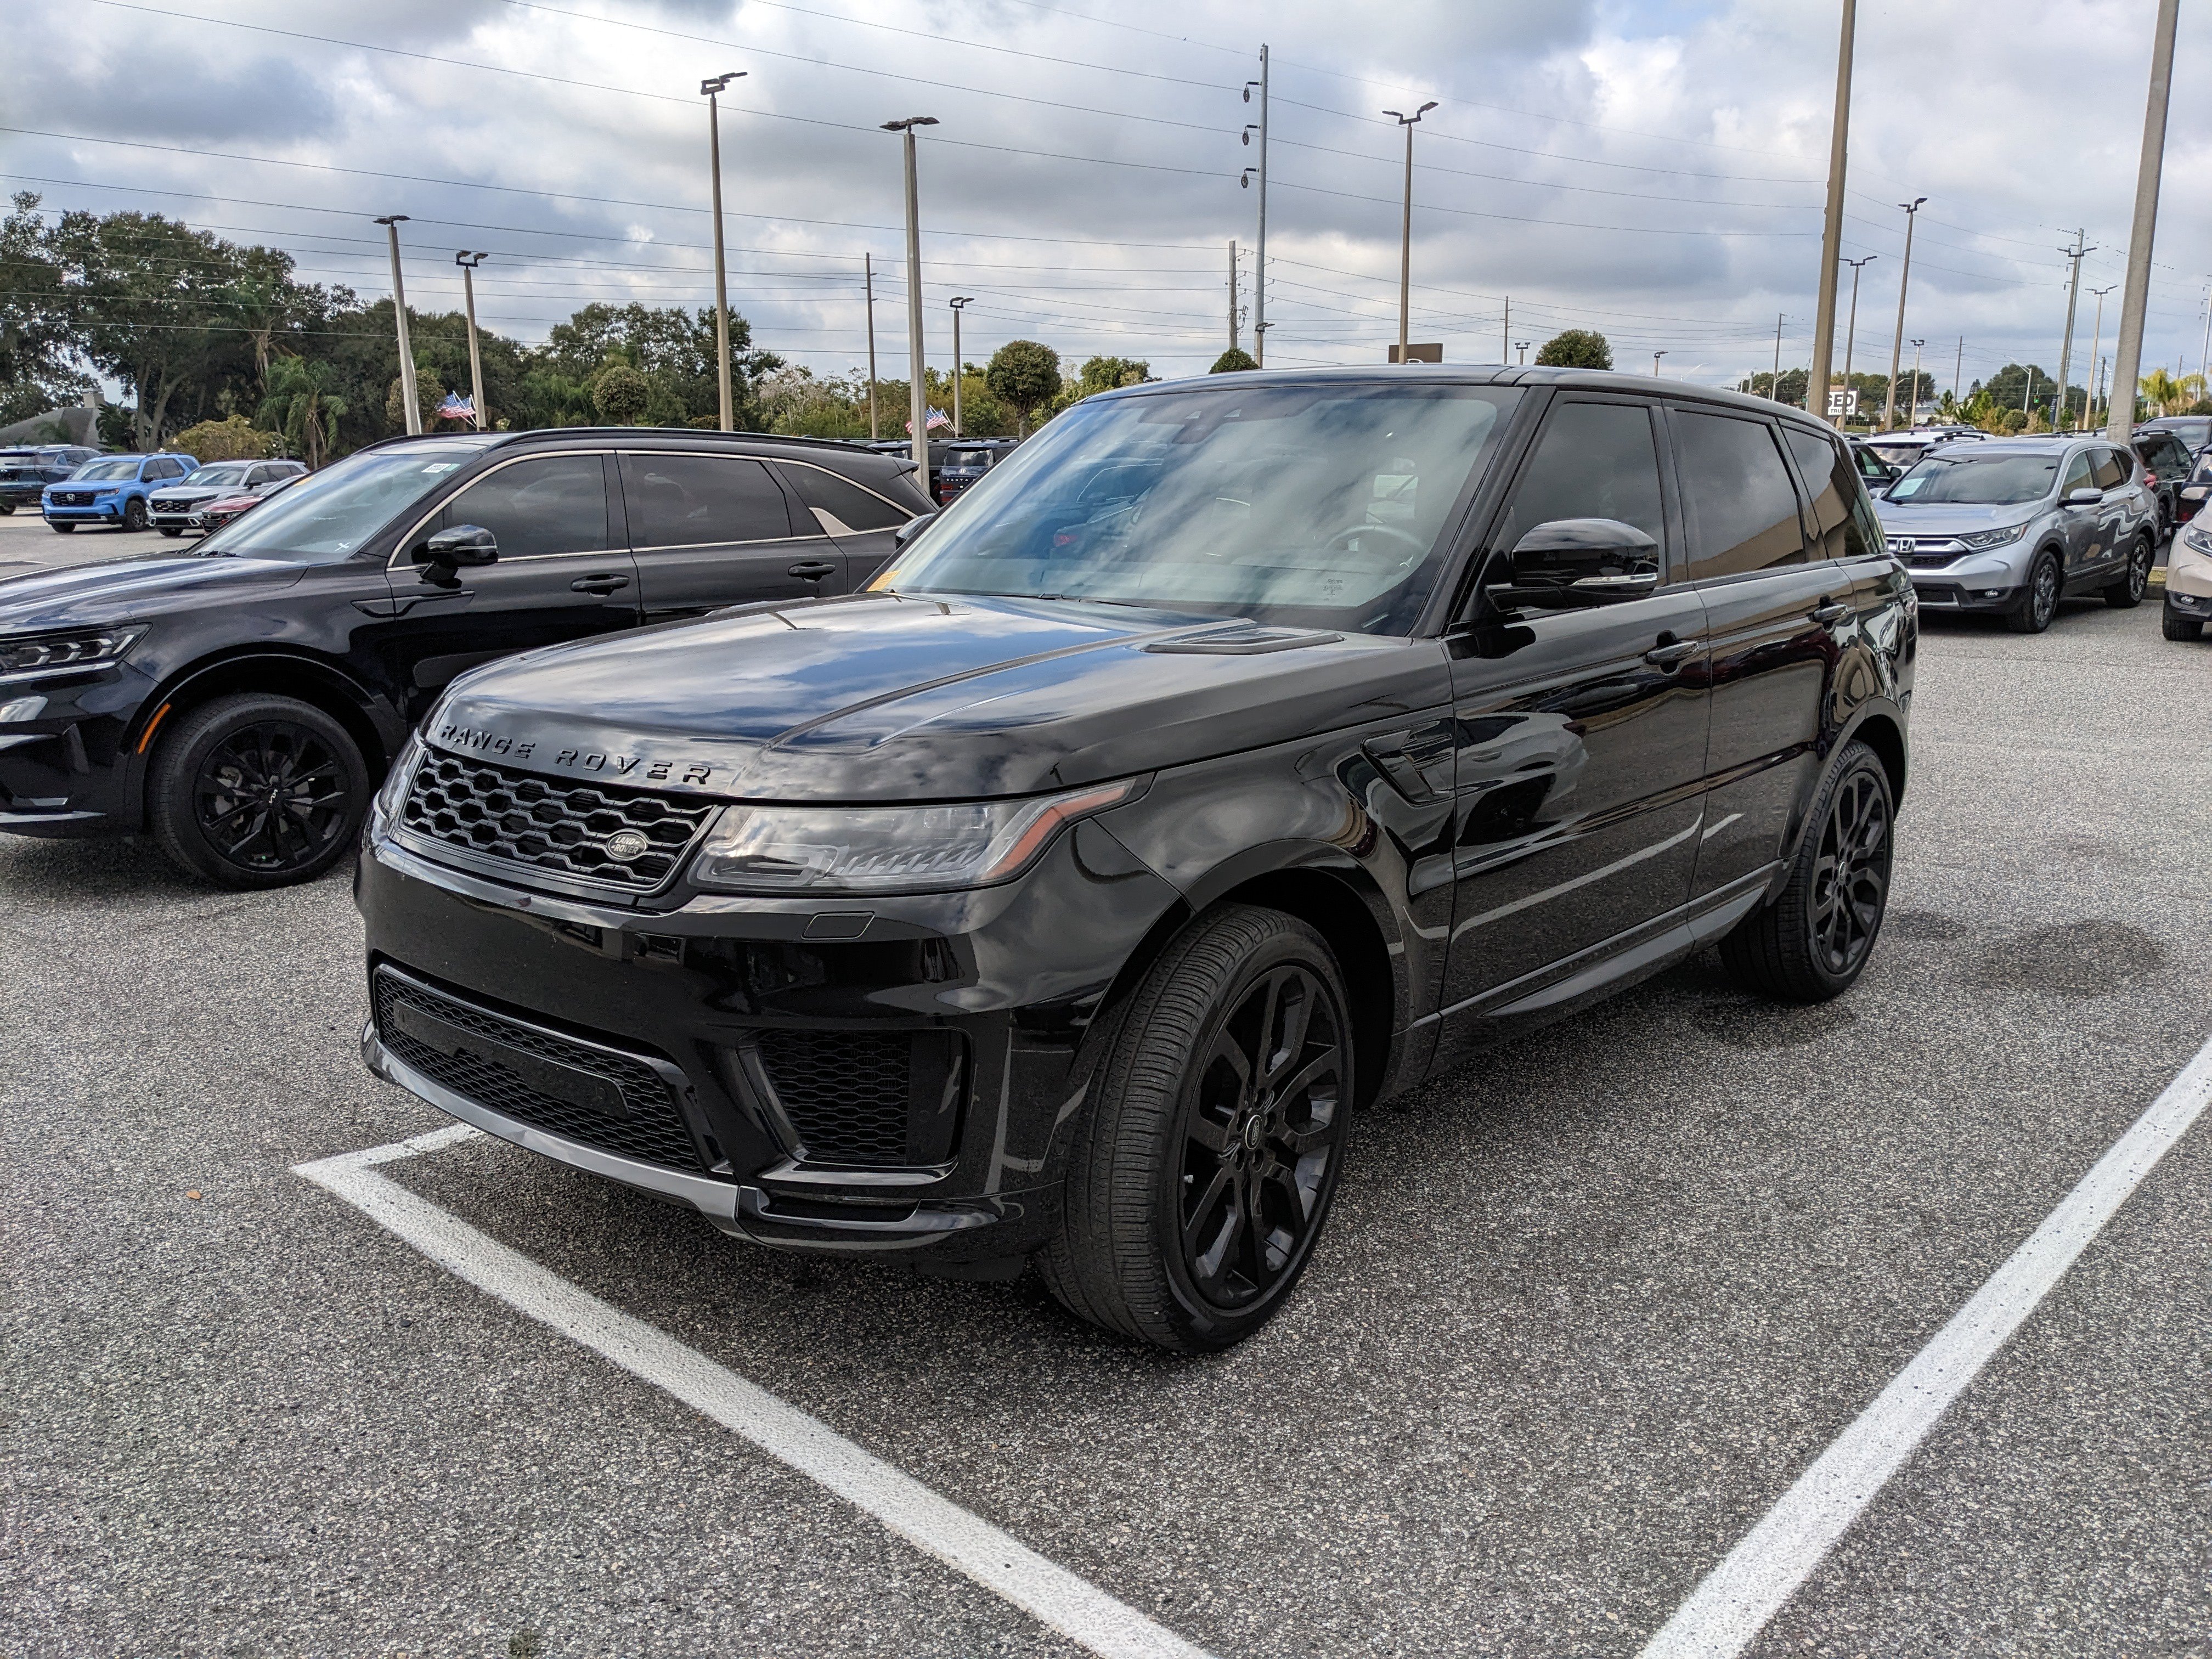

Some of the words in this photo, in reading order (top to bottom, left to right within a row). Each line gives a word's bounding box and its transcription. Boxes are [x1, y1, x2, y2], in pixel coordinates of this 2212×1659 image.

[441, 723, 536, 759] RANGE
[554, 748, 711, 785] ROVER
[615, 836, 636, 845] LAND
[614, 844, 639, 854] ROVER
